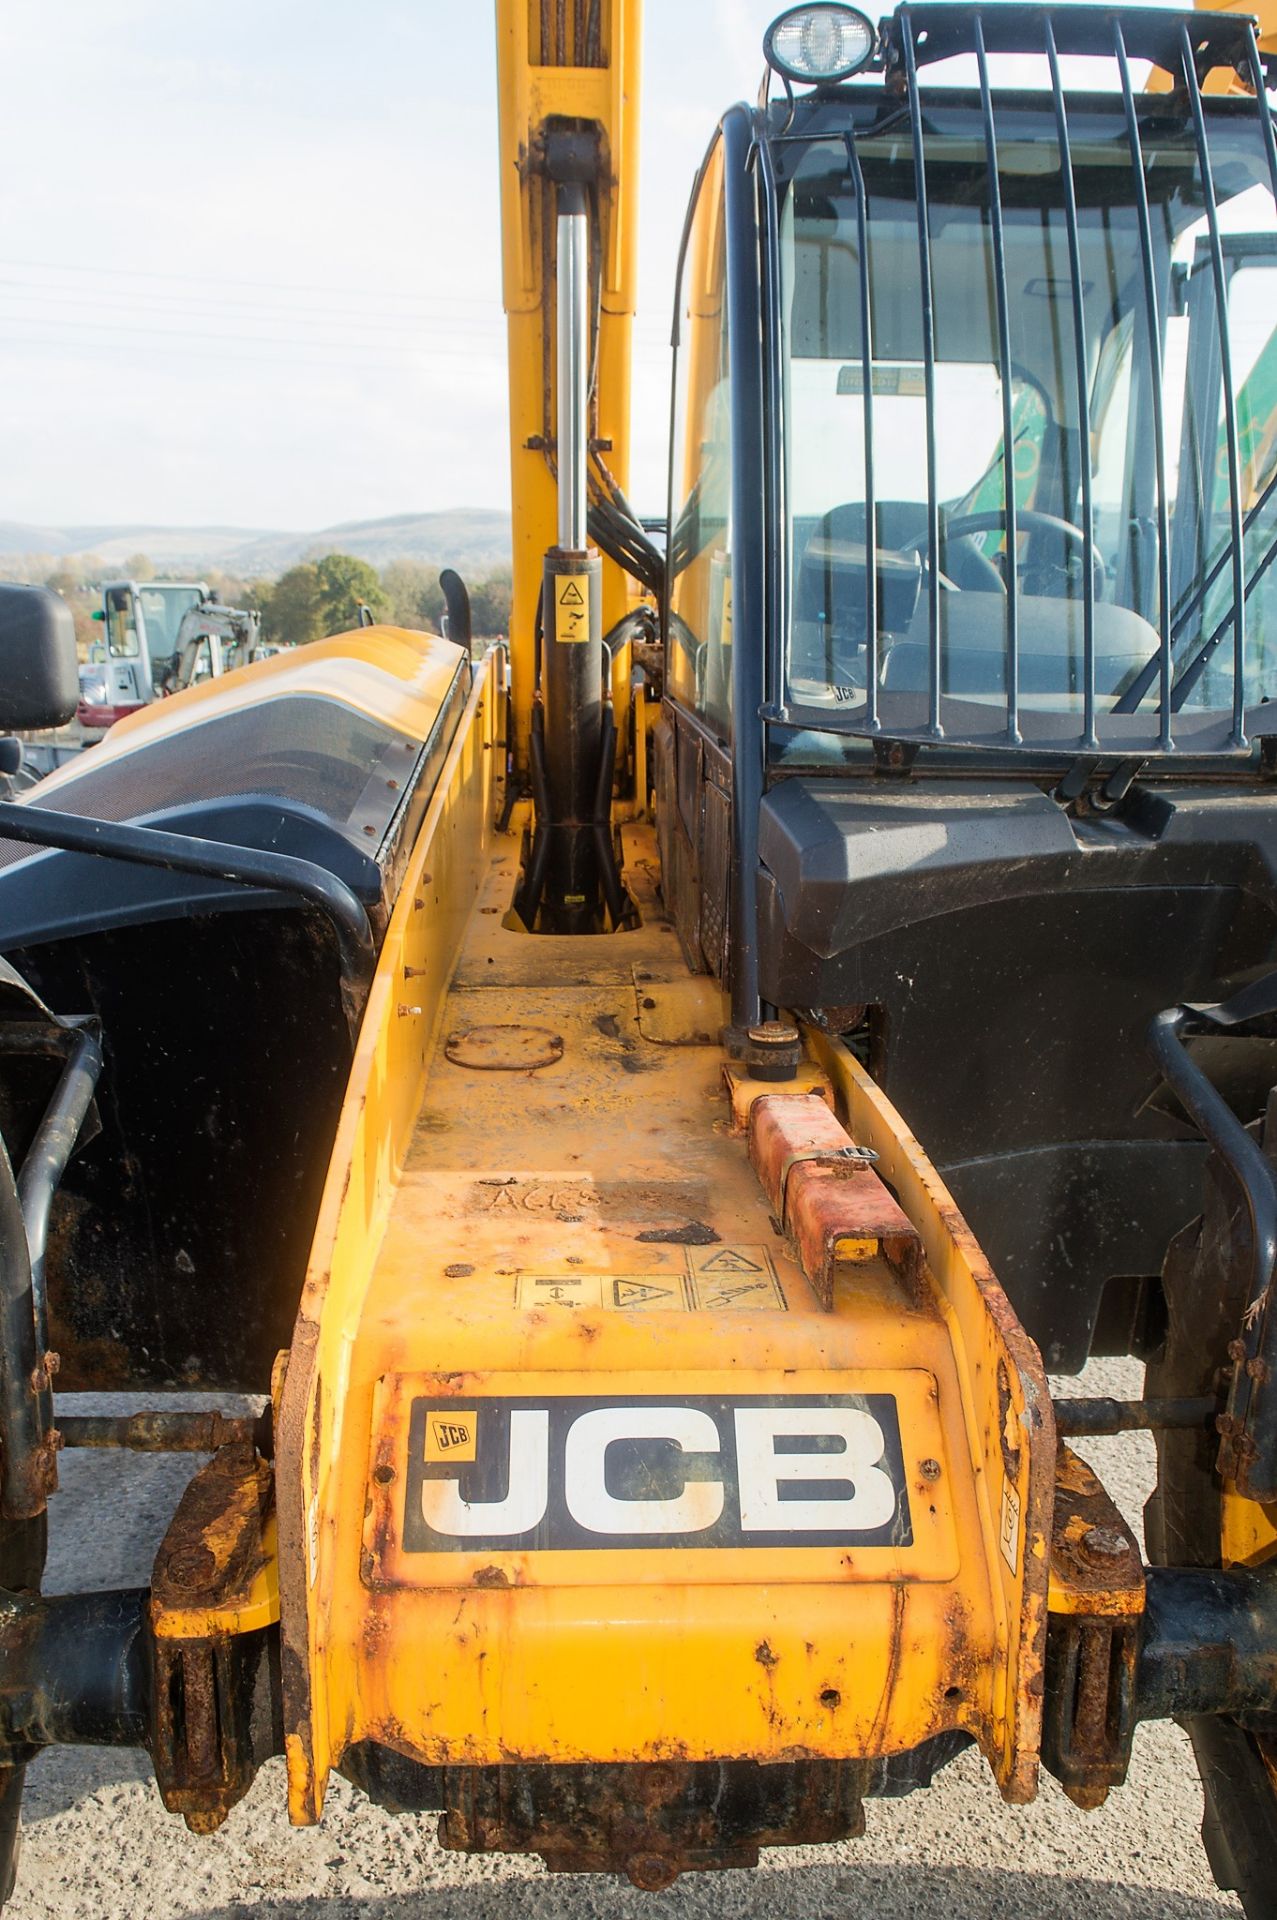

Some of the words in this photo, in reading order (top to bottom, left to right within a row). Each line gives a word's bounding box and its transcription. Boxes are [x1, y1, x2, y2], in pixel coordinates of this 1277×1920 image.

[836, 686, 854, 701] JCB
[439, 1424, 468, 1448] JCB
[421, 1407, 896, 1537] JCB
